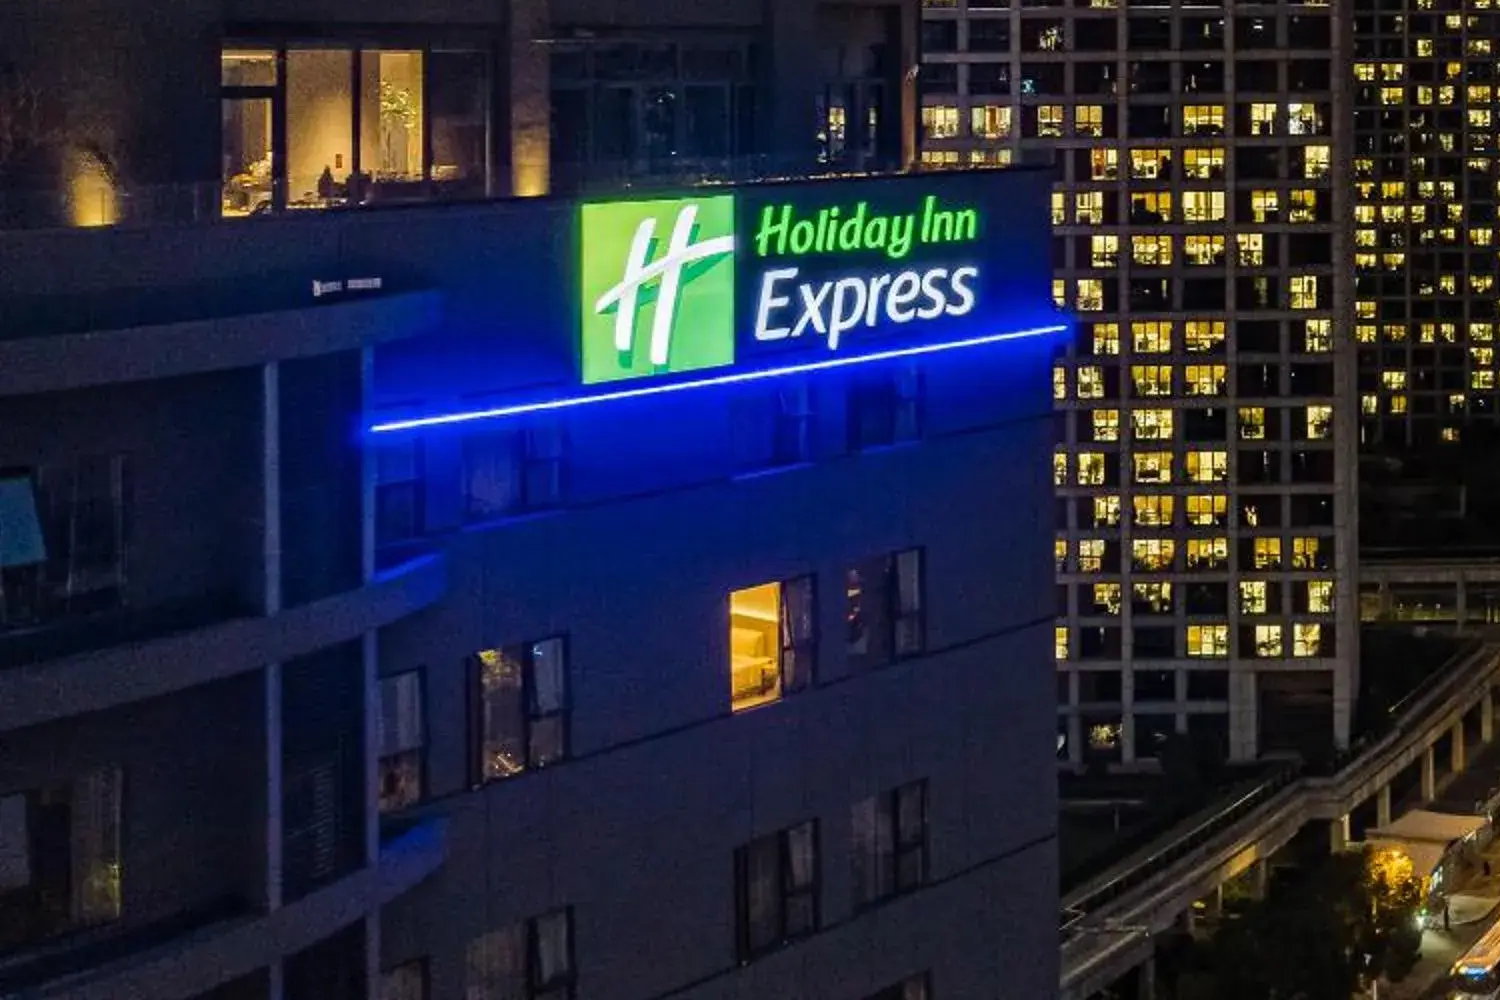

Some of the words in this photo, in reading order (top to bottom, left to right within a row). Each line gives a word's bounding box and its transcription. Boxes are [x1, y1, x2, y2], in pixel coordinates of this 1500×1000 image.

[755, 201, 915, 259] Holiday
[920, 195, 977, 243] Inn
[754, 266, 979, 351] Express
